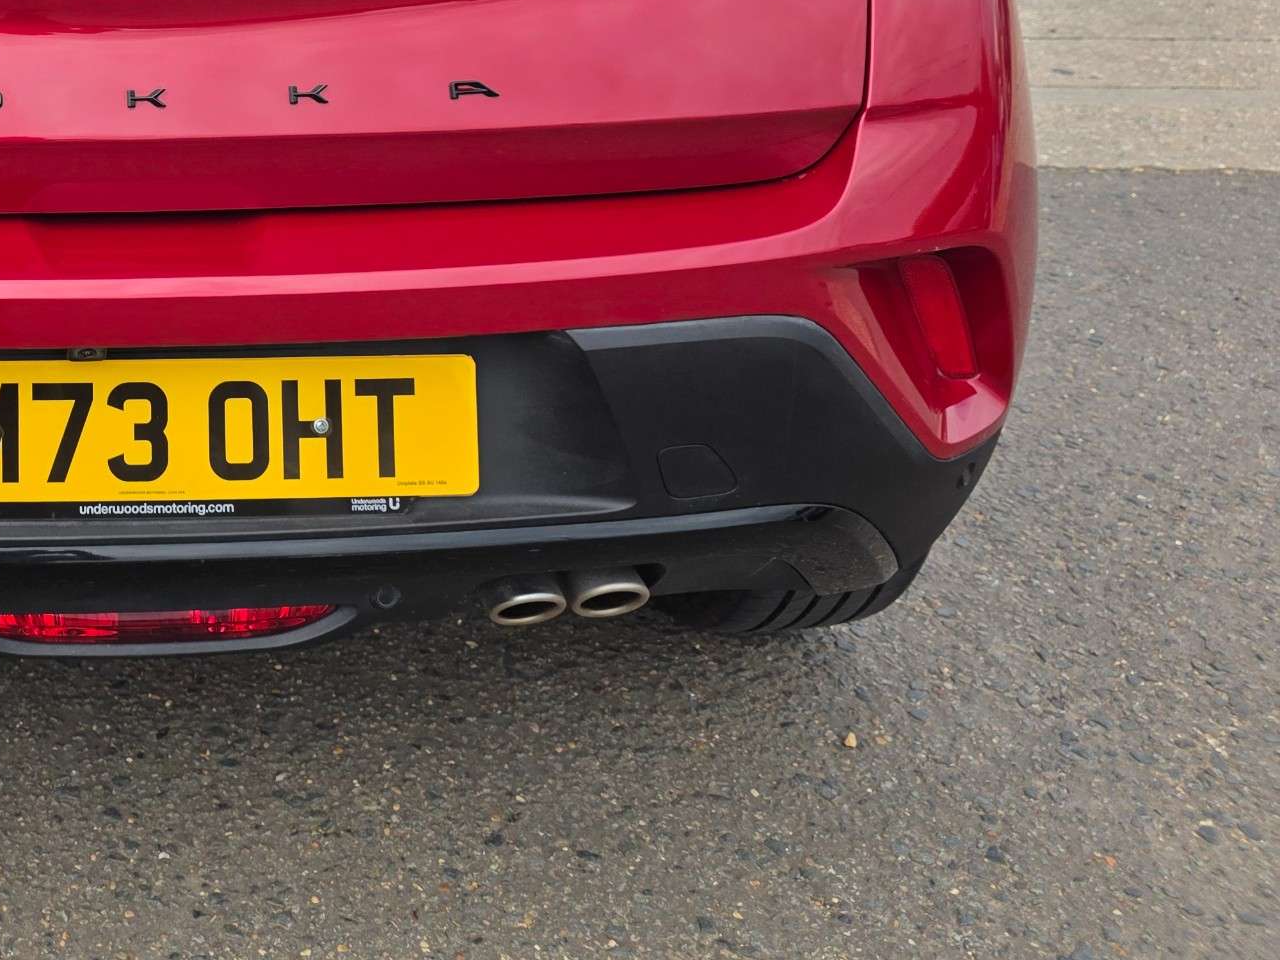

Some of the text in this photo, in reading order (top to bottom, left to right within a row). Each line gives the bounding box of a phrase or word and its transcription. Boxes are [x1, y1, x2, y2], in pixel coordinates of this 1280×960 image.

[207, 378, 416, 481] OHT
[79, 502, 235, 516] underwoodsmotoring.com
[351, 503, 387, 512] motoring
